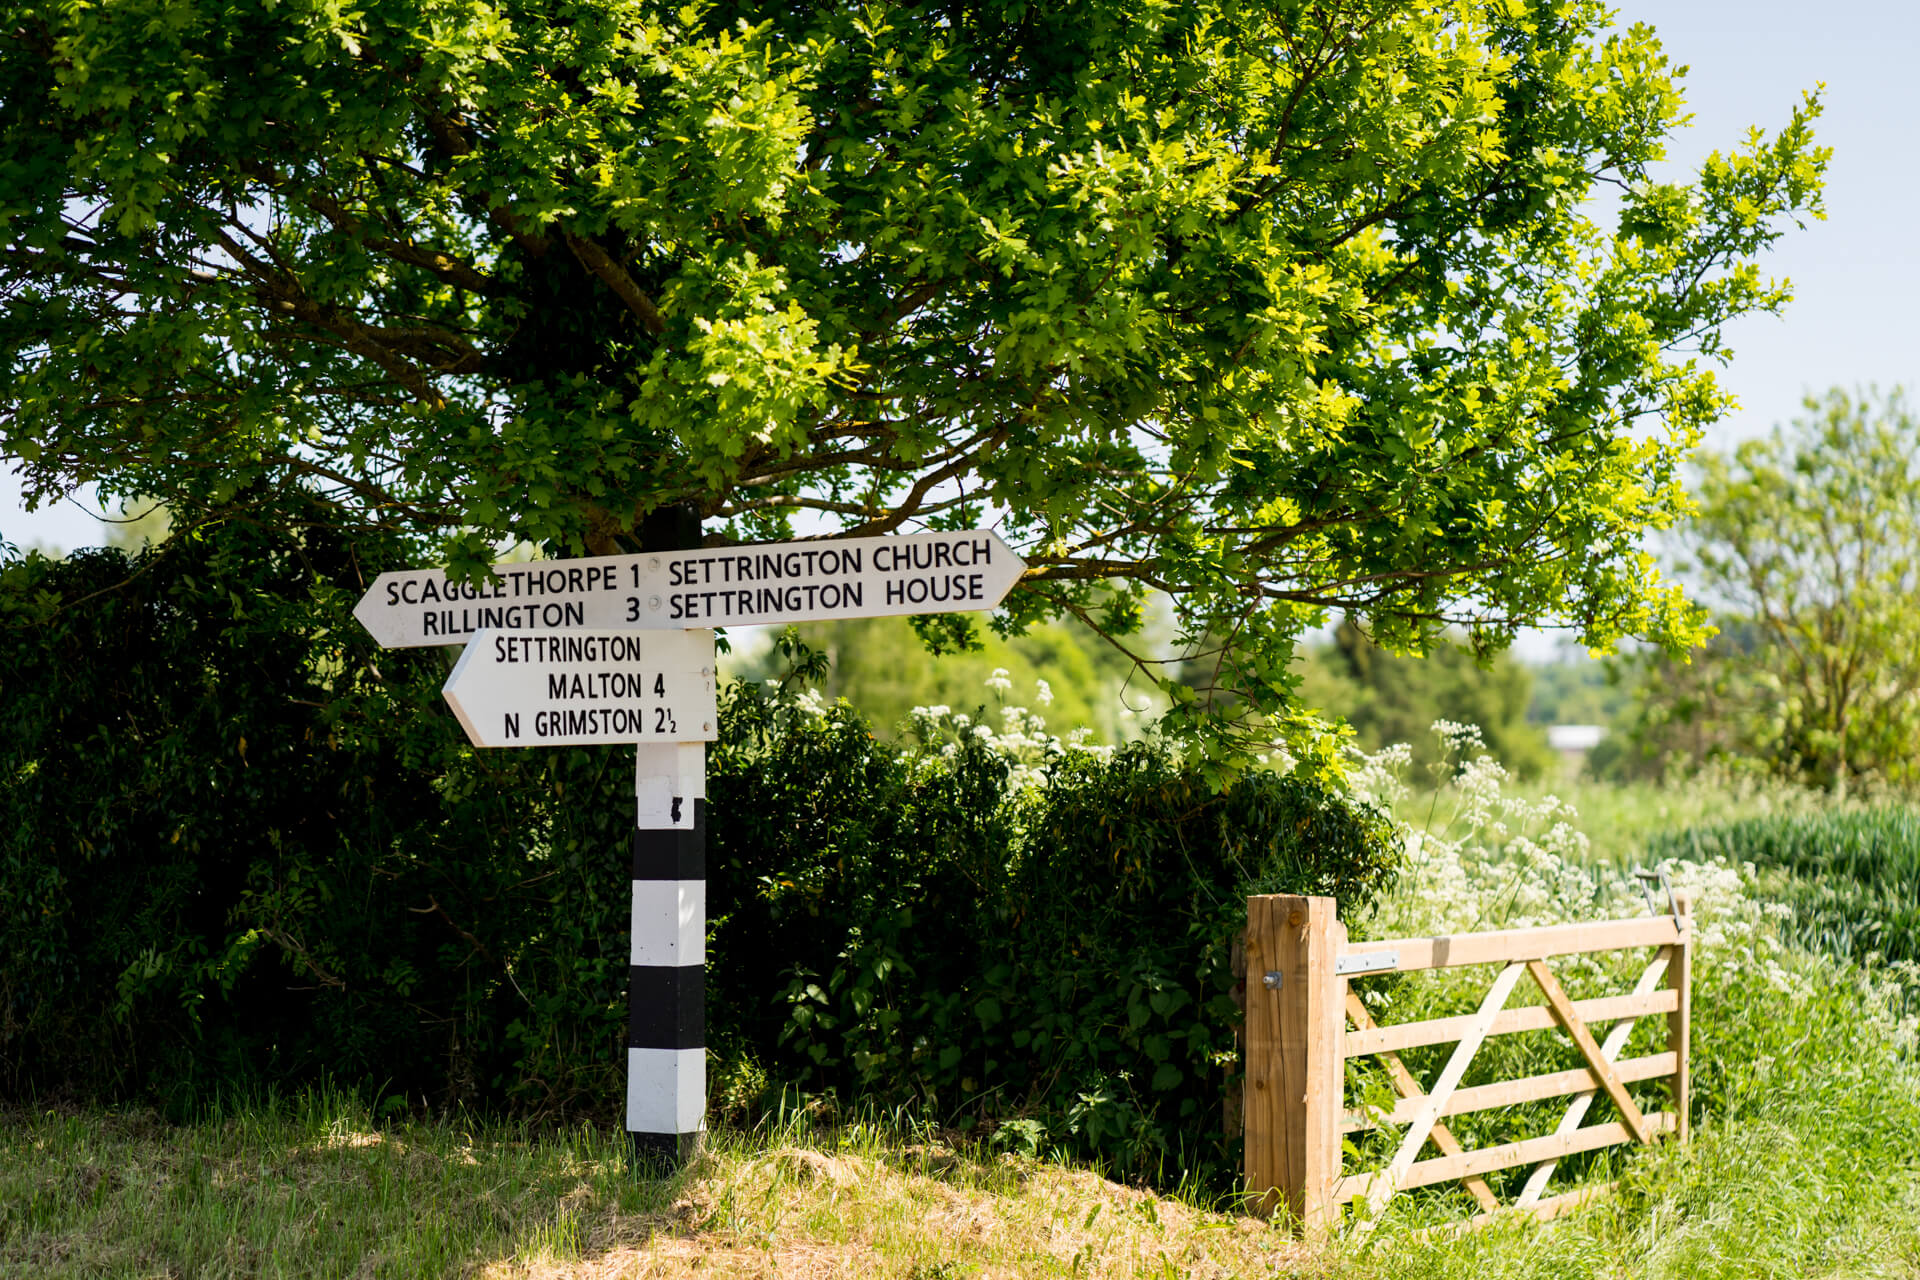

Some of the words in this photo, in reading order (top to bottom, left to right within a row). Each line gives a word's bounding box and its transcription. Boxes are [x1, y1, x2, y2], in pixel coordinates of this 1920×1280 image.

[630, 563, 639, 589] 1
[669, 548, 862, 586] SETTRINGTON
[873, 539, 991, 572] CHURCH
[669, 582, 863, 620] SETTRINGTON
[886, 574, 984, 605] HOUSE
[423, 601, 584, 636] RILLINGTON
[626, 597, 640, 622] 3
[495, 636, 641, 663] SETTRINGTON
[548, 672, 641, 699] MALTON
[654, 673, 665, 698] 4
[504, 713, 520, 739] N
[535, 709, 642, 737] GRIMSTON
